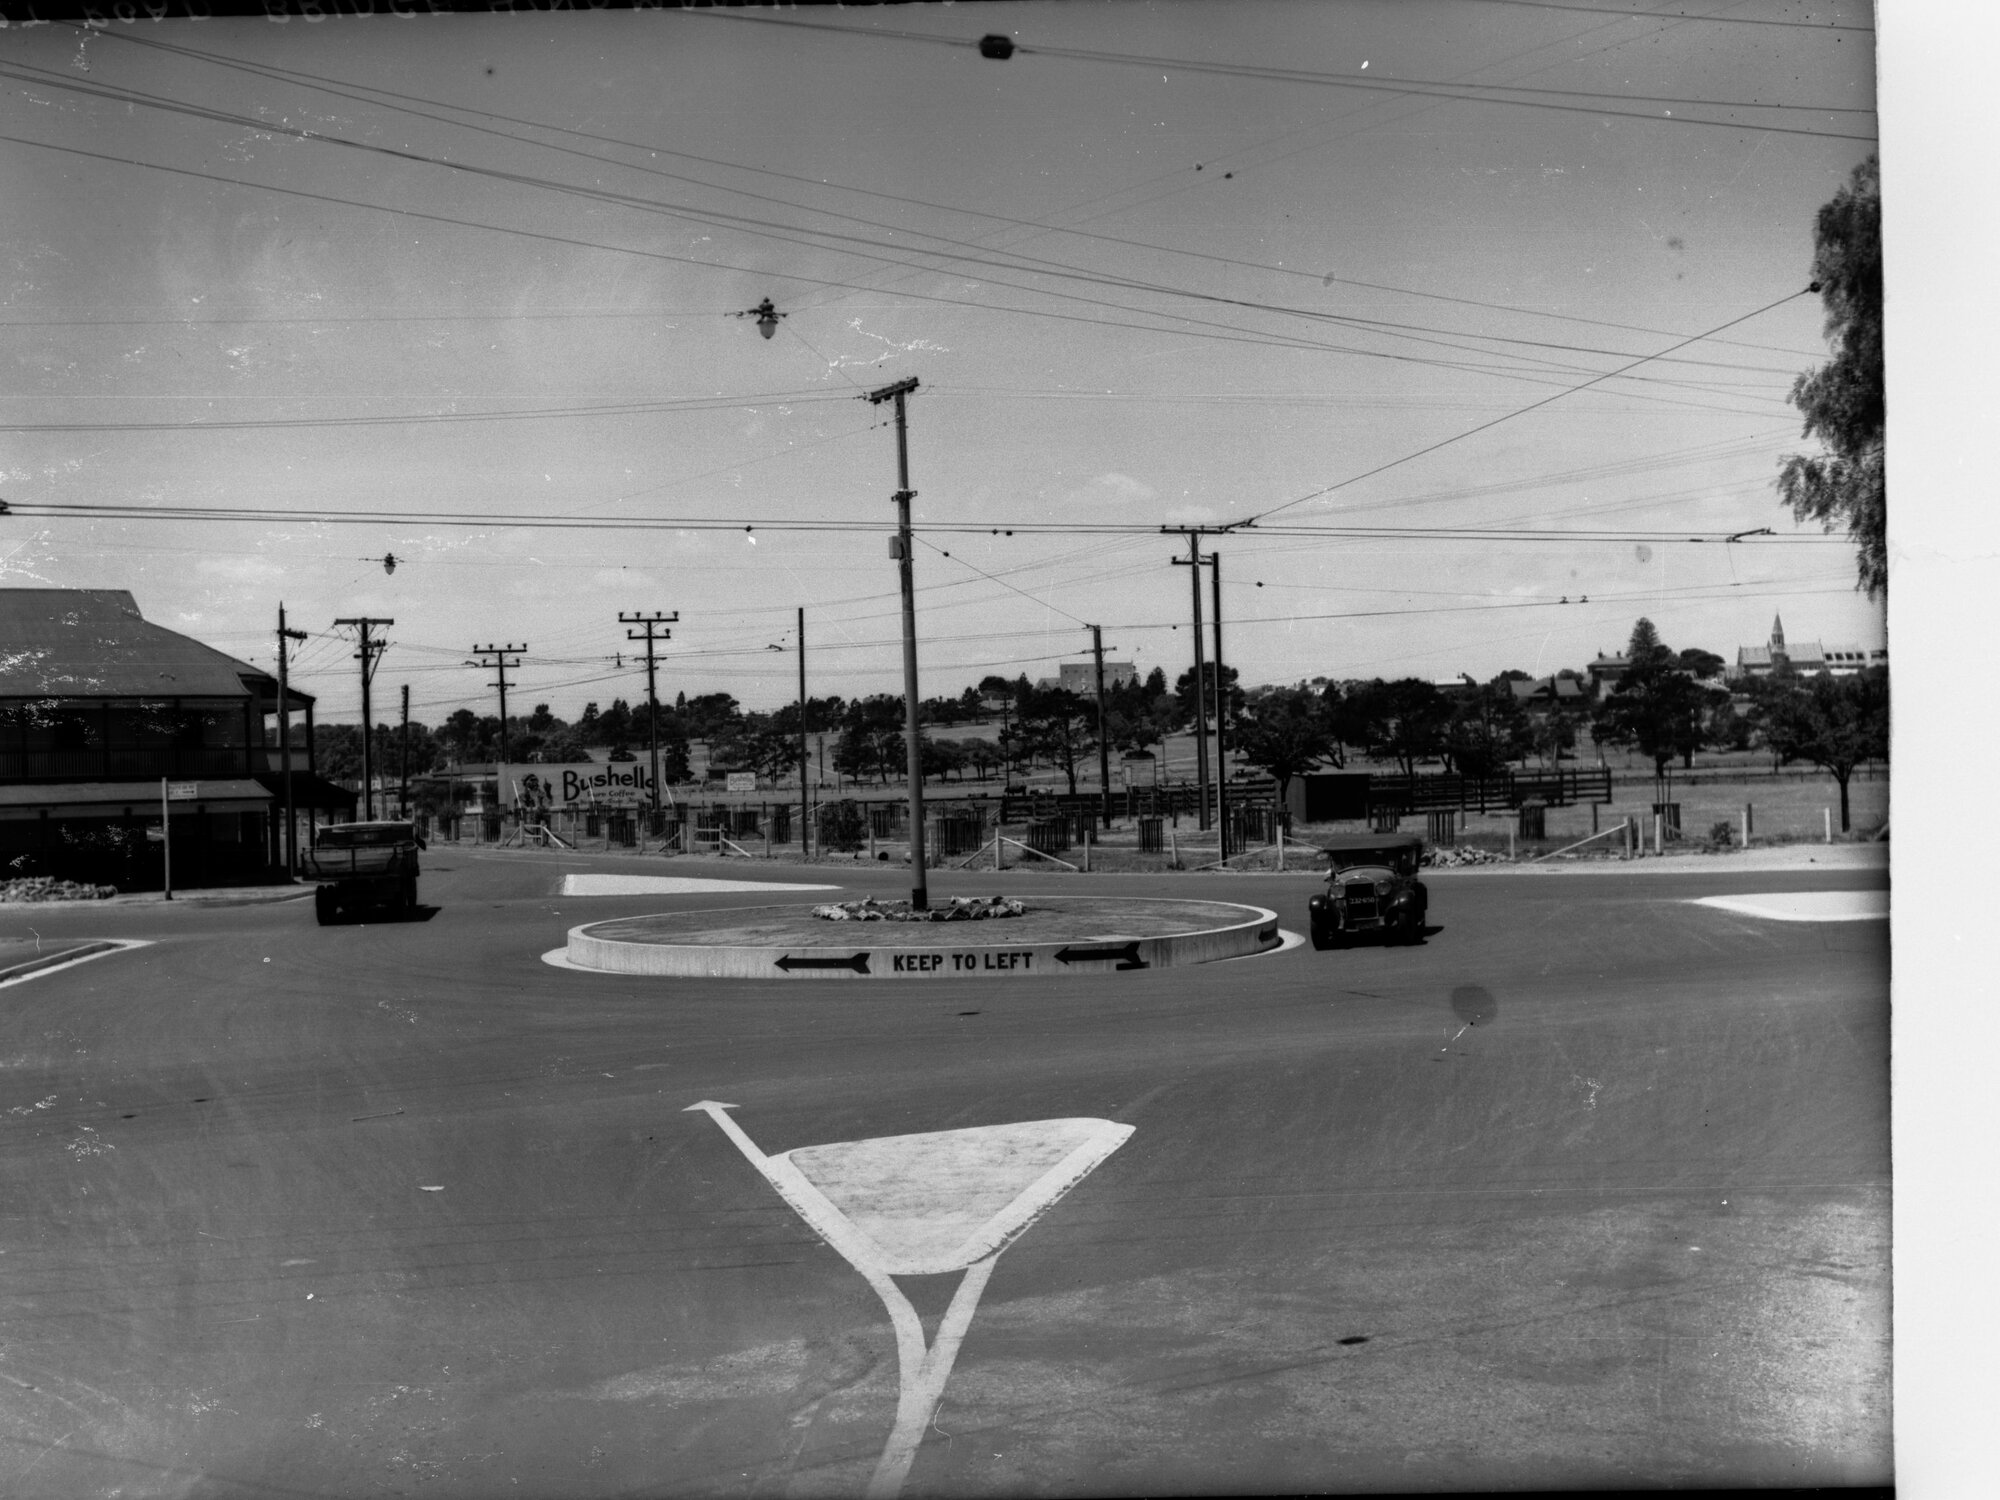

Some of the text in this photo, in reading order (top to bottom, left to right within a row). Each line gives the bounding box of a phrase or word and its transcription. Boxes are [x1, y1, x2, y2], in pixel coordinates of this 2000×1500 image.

[608, 789, 636, 798] Coffee
[893, 952, 1034, 972] KEEP TO LEFT
